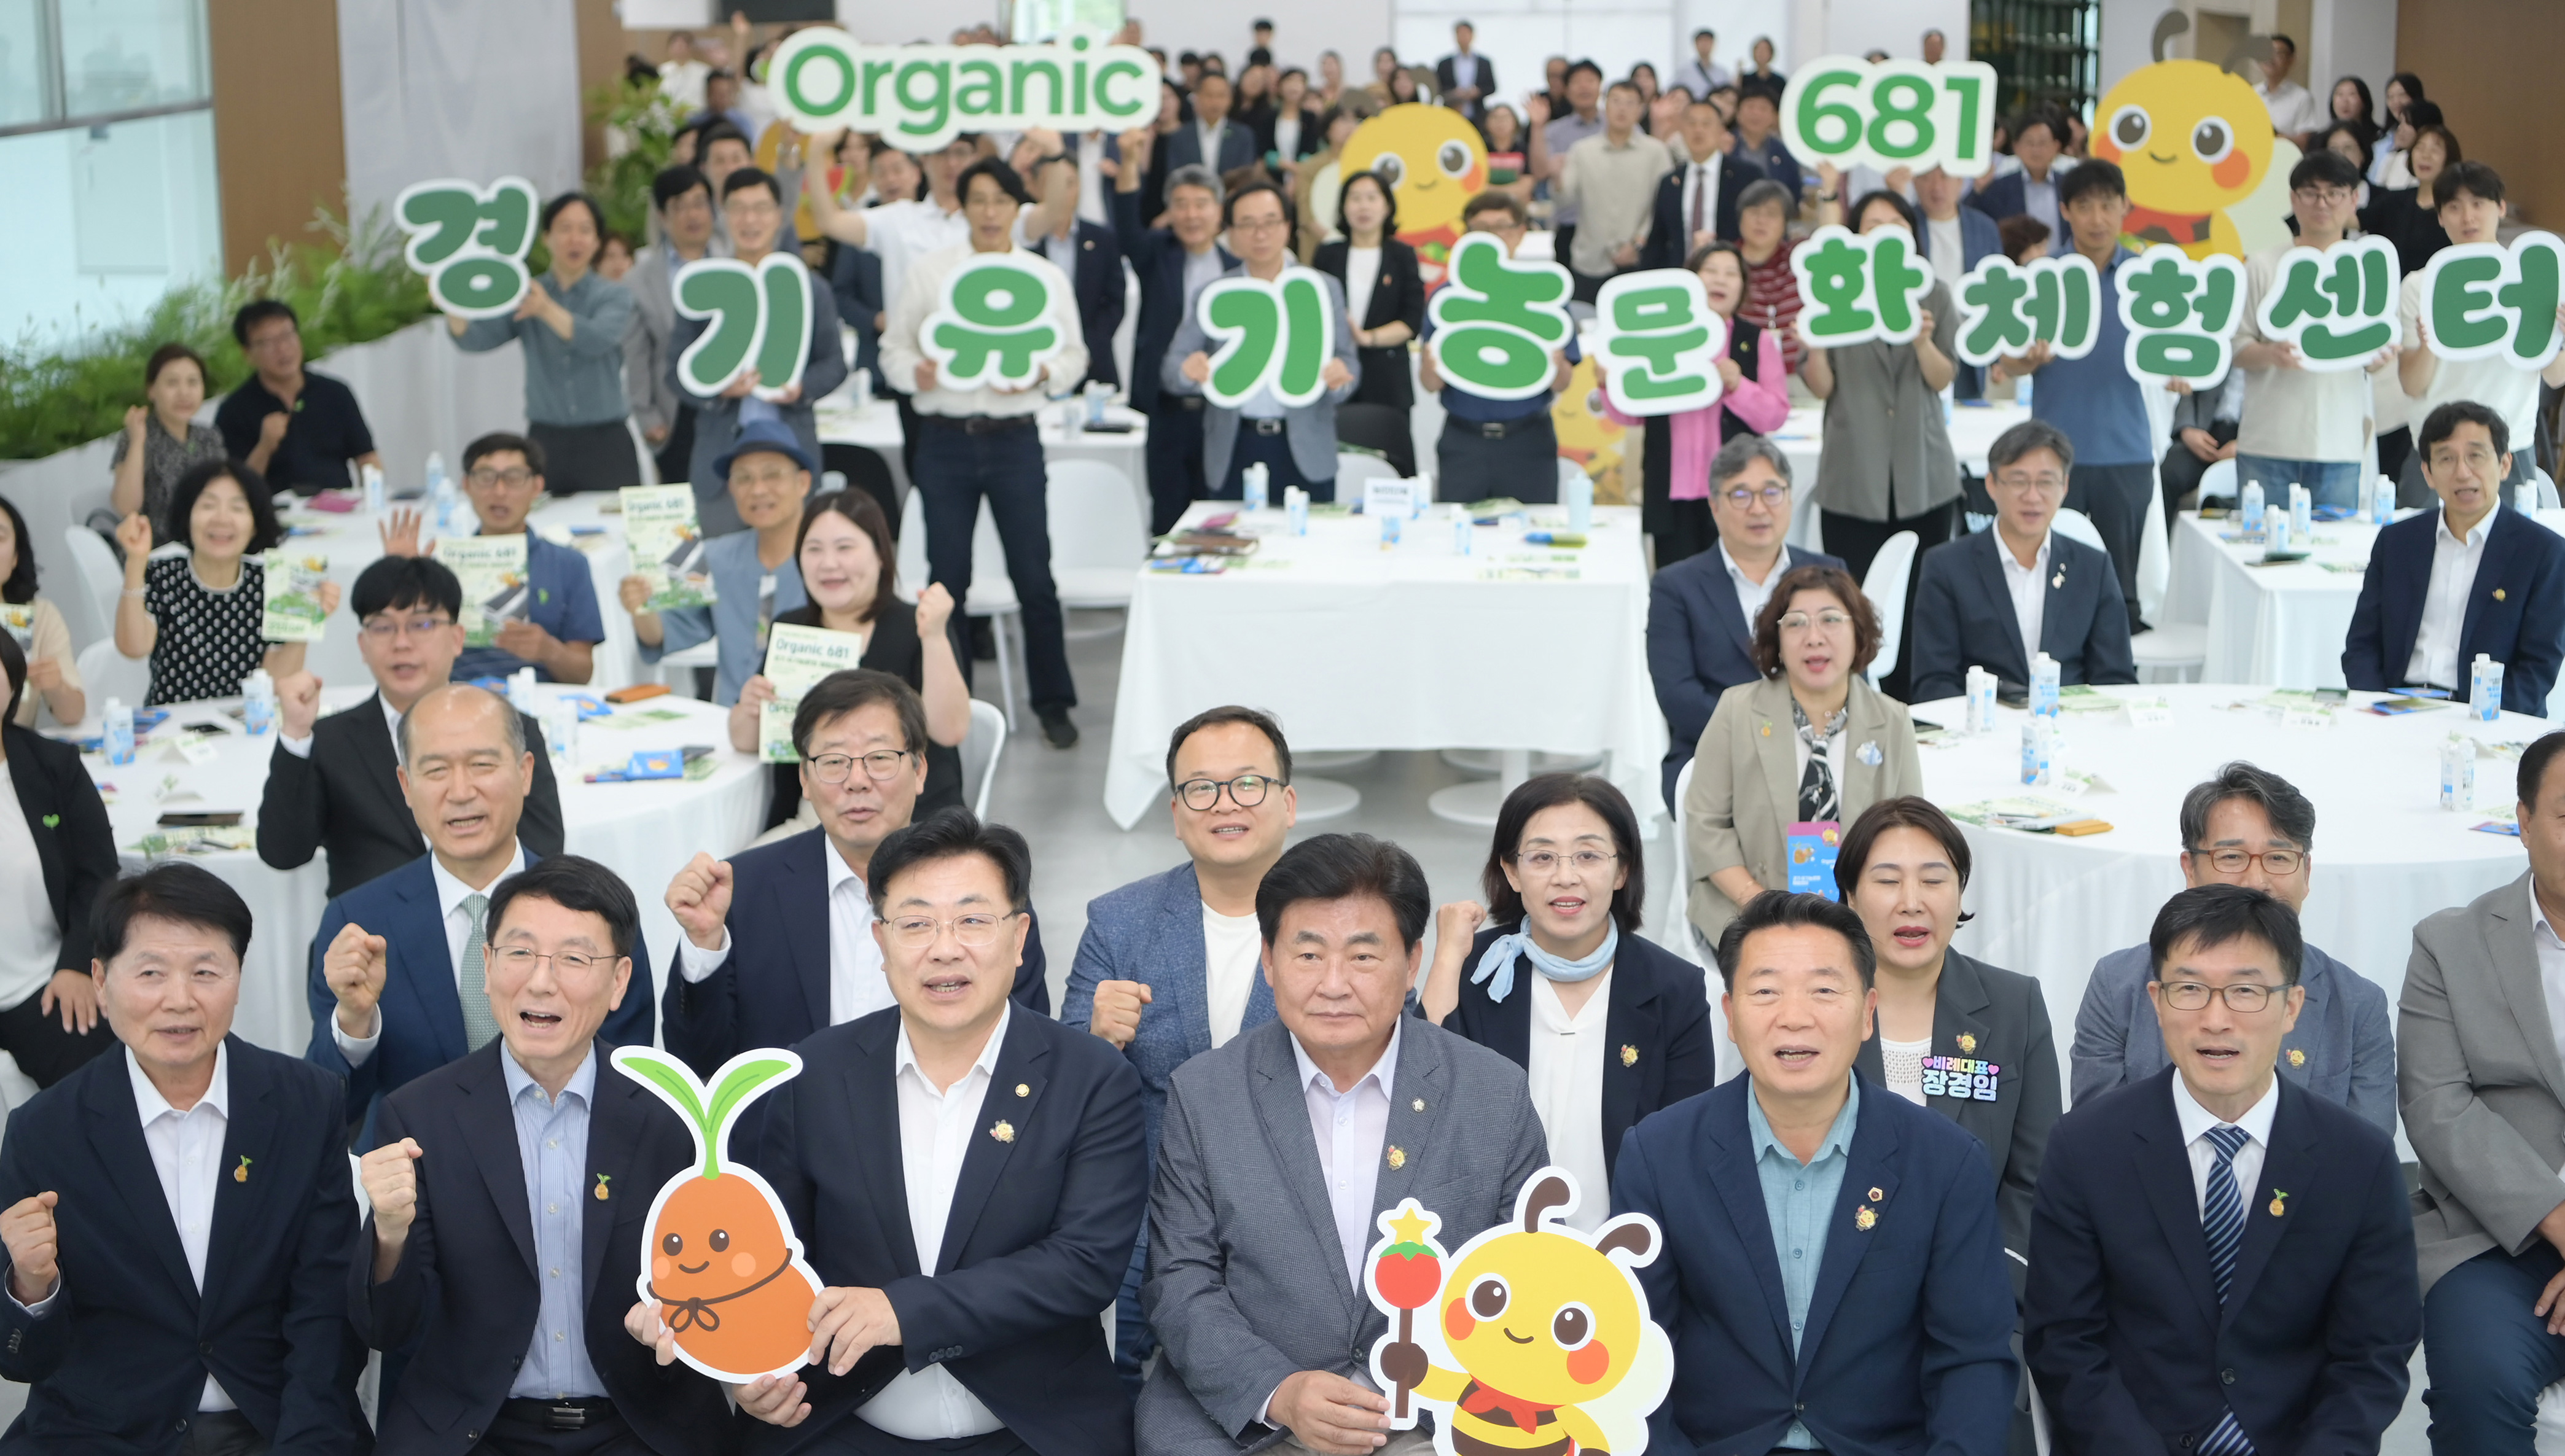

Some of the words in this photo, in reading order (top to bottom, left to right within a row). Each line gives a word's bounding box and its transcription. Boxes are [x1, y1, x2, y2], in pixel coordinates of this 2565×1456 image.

[785, 36, 1144, 135] Organic
[1797, 70, 1981, 160] 681
[405, 188, 528, 308] 경
[1803, 237, 1924, 337] 화
[2431, 244, 2560, 359] 터
[681, 264, 804, 388] 기
[934, 267, 1055, 378] 유
[1209, 278, 1324, 397] 기
[1439, 241, 1565, 390] 농
[1609, 286, 1709, 400] 문
[1964, 267, 2091, 355] 체
[2126, 258, 2236, 378] 험
[2269, 249, 2392, 360] 센
[776, 638, 822, 656] Organic
[827, 644, 849, 659] 681
[1922, 1069, 1998, 1102] 장경임
[1932, 1055, 1989, 1075] 비례대표
